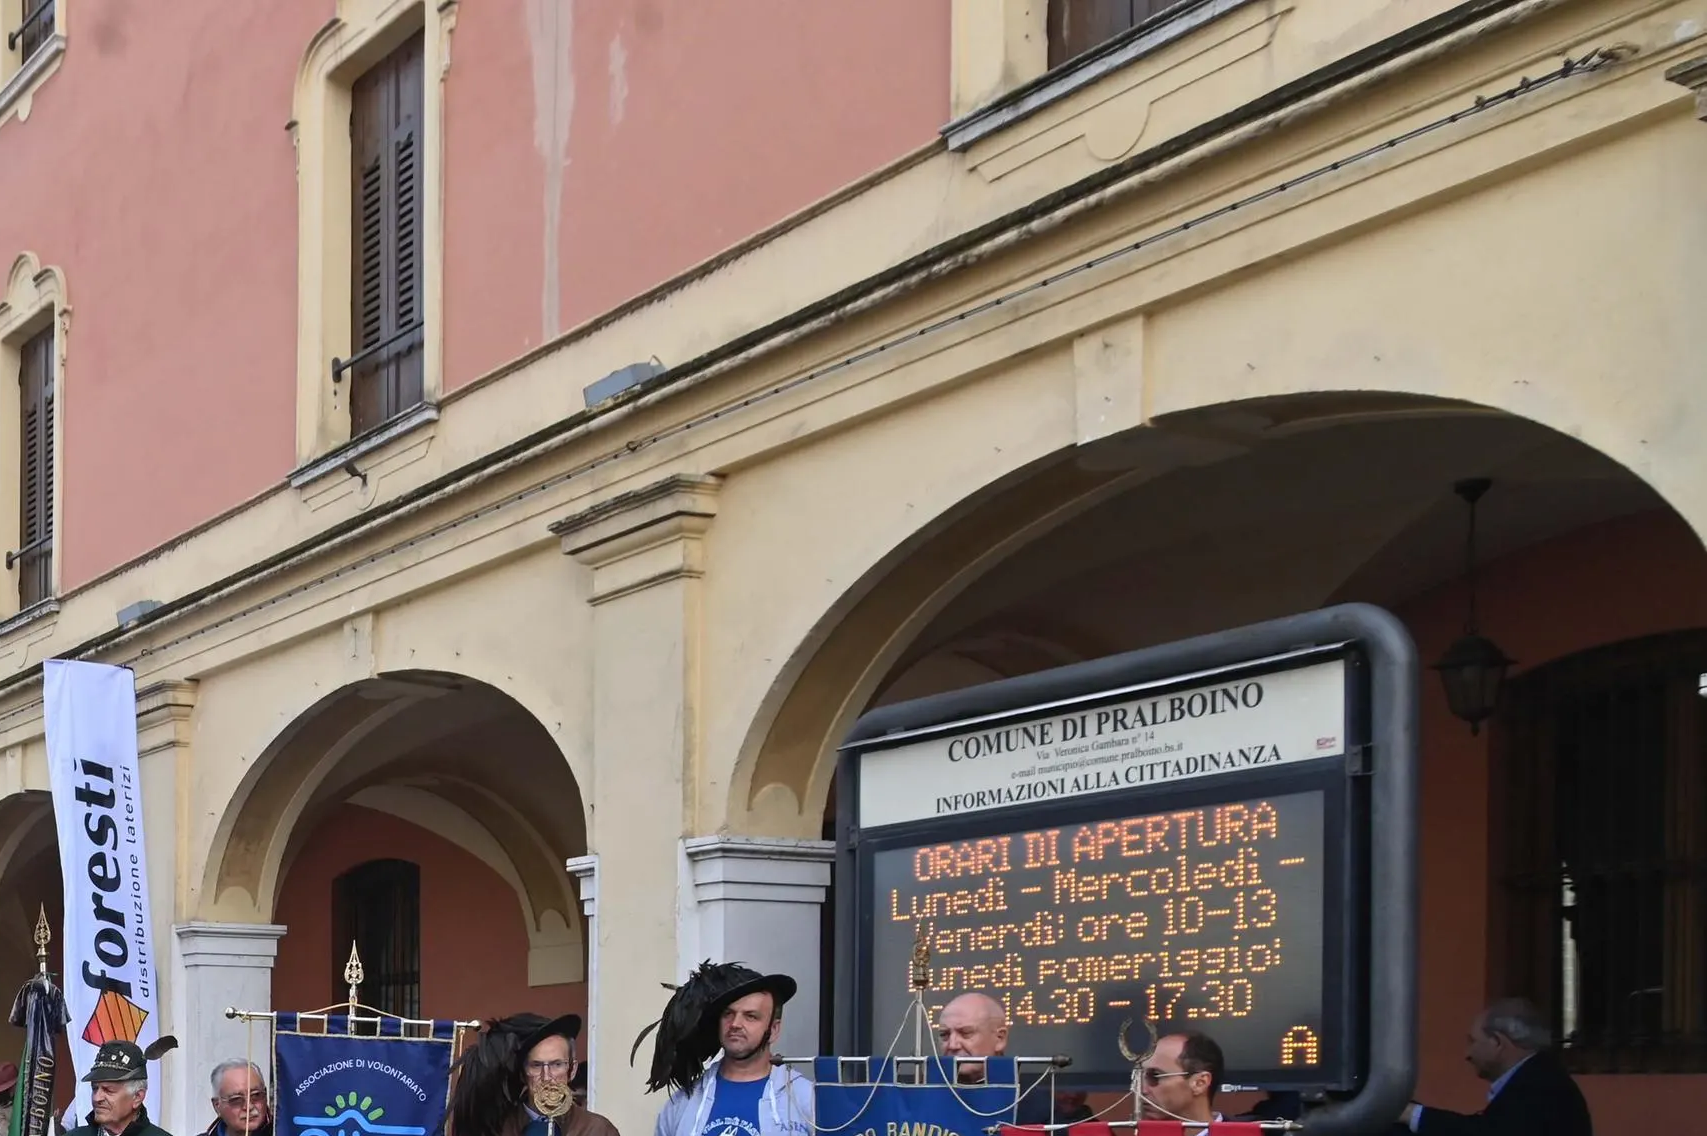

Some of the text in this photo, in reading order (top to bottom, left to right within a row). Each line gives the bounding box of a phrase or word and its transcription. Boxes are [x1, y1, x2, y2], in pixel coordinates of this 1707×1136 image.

[948, 682, 1264, 762] COMUNE DI PRALBOINO
[1145, 730, 1155, 742] 14
[936, 743, 1282, 814] INFORMAZIONI ALLA CITTADINANZA
[1011, 766, 1036, 780] e-mail
[914, 801, 1277, 882] ORARI DI APERTURA
[73, 758, 134, 999] foresti
[119, 764, 150, 998] distribuzione laterizi
[891, 876, 1008, 921] Lunedì
[1054, 847, 1262, 904] Mercoledì
[1077, 911, 1148, 942] ore
[1162, 888, 1277, 936] 10-13
[1001, 987, 1095, 1027] 14.30
[1144, 977, 1253, 1021] 17.30
[1281, 1024, 1318, 1065] A
[295, 1058, 427, 1102] ASSOCIAZIONE DI VOLONTARIATO
